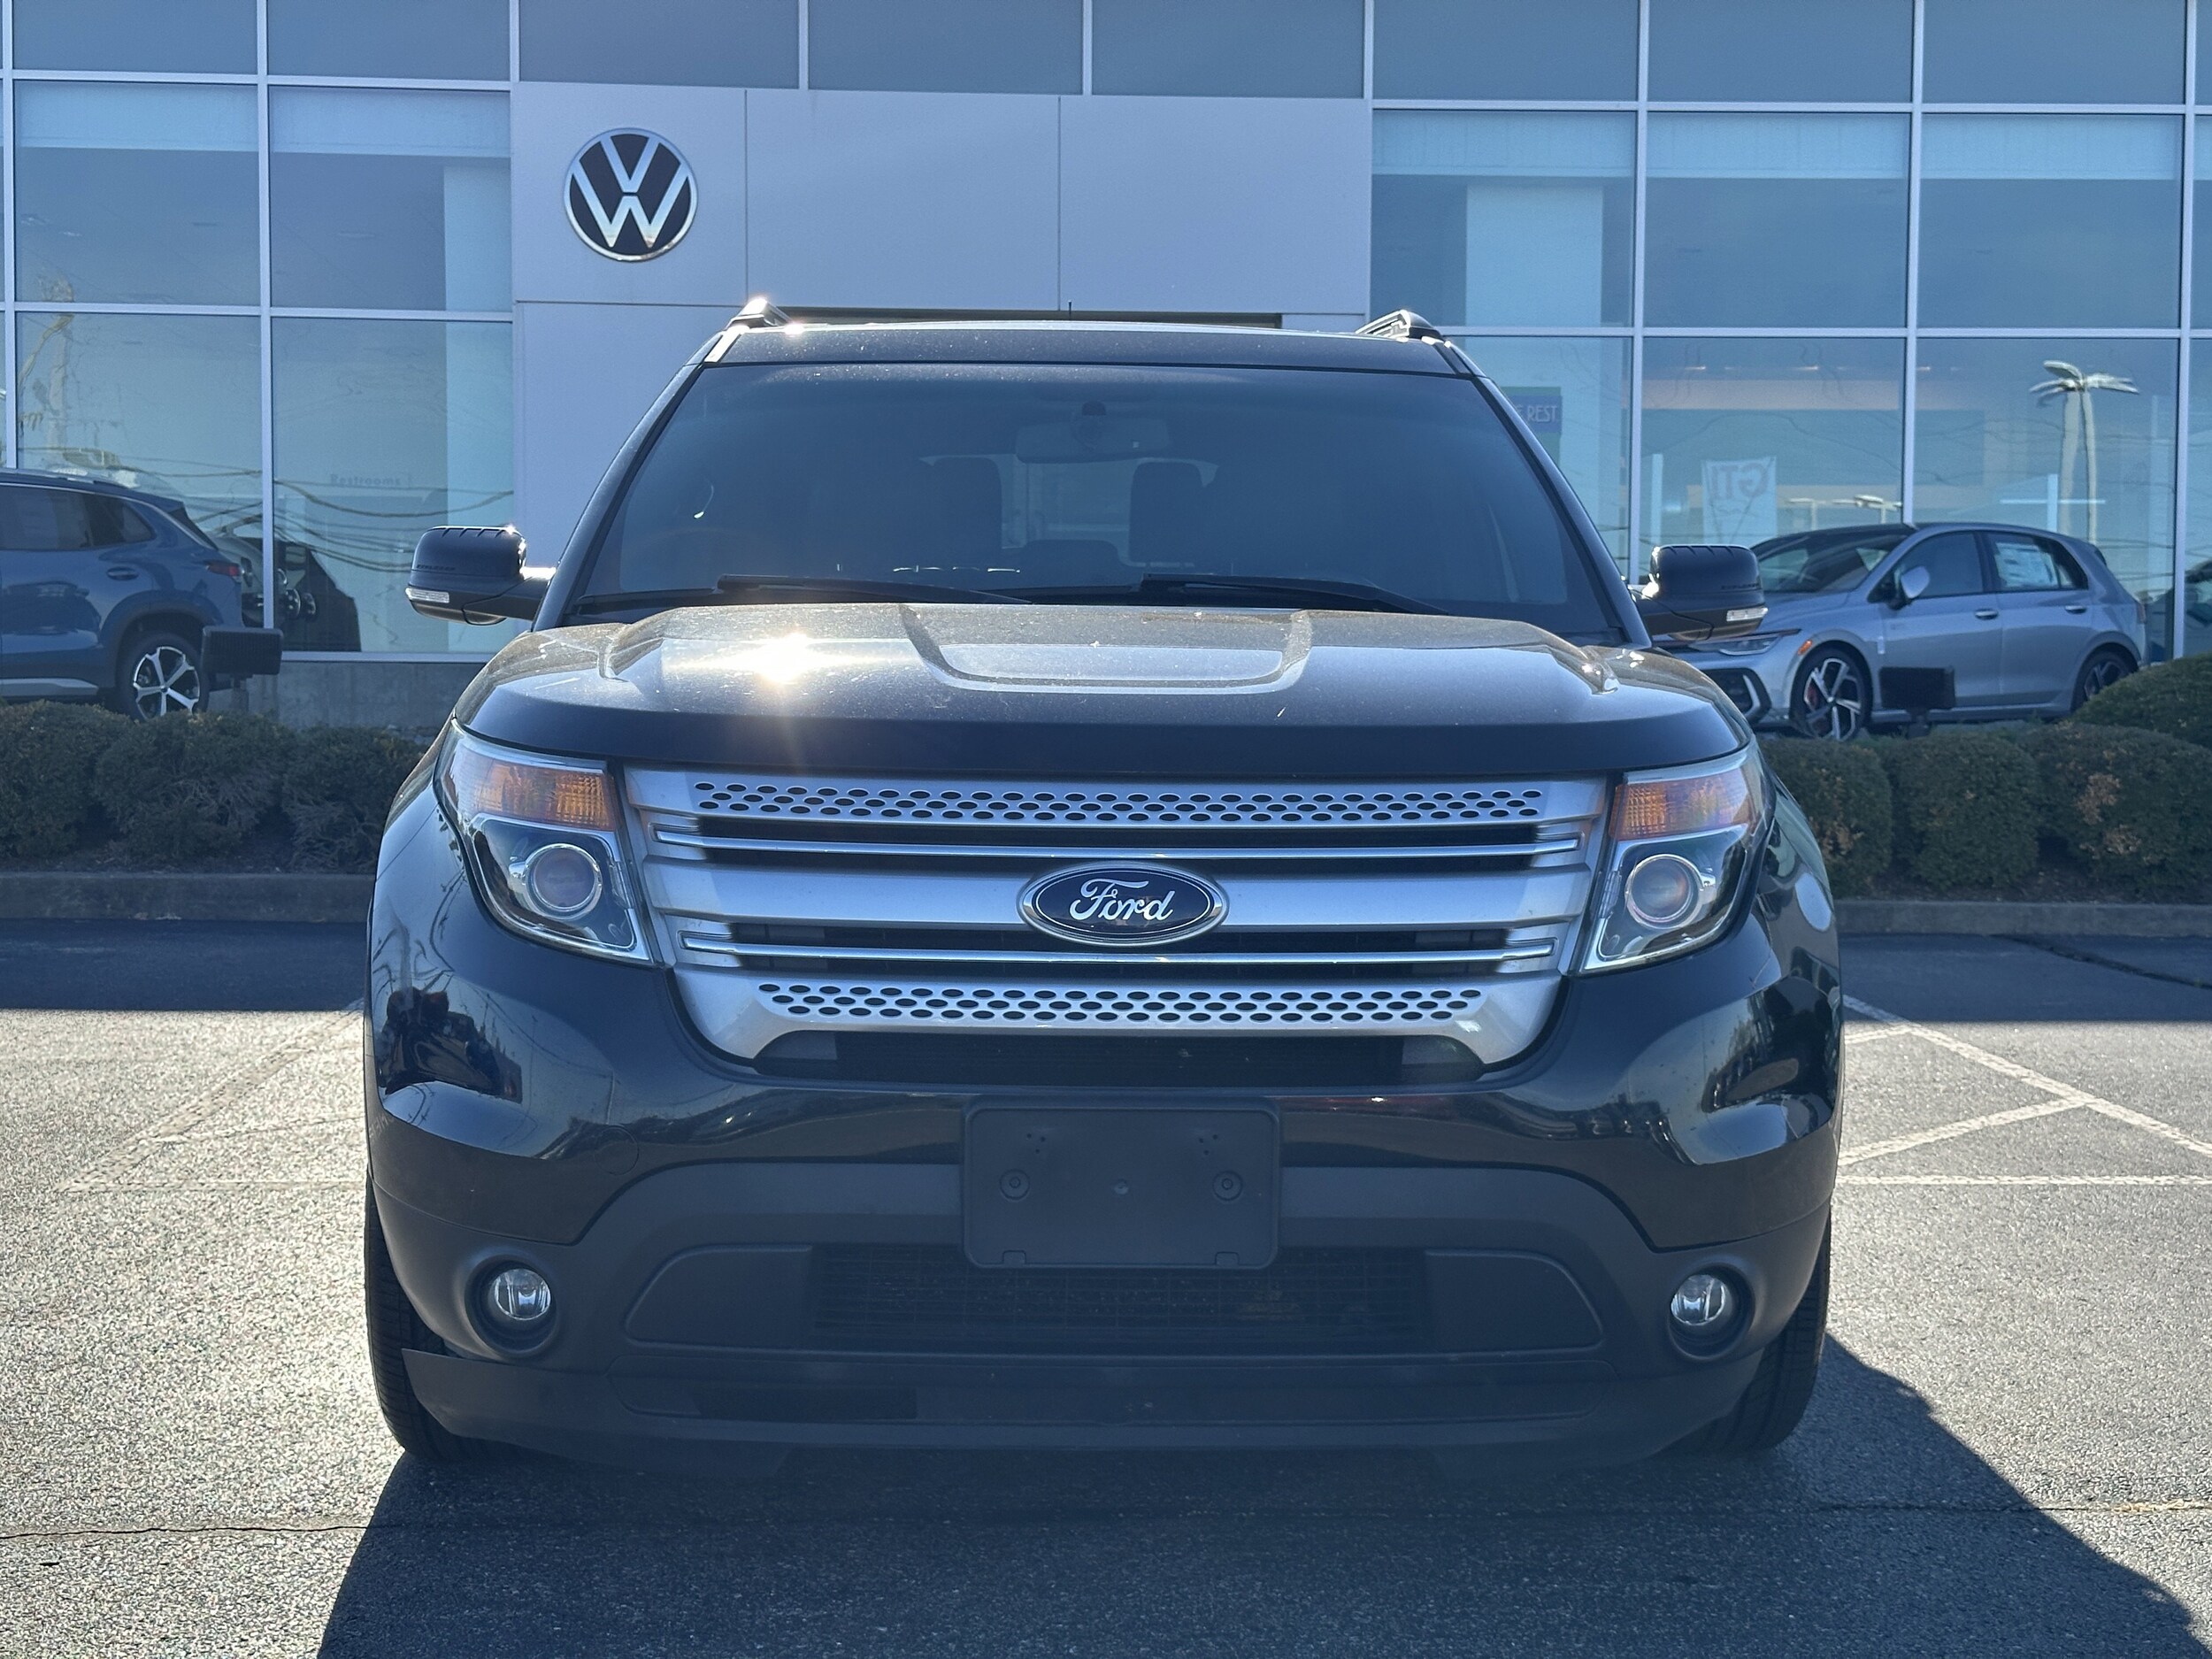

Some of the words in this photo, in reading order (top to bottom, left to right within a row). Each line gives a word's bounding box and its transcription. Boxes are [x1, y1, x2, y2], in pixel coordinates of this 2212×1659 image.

[1527, 404, 1558, 422] REST
[330, 473, 402, 487] Restrooms
[1069, 878, 1176, 921] Ford
